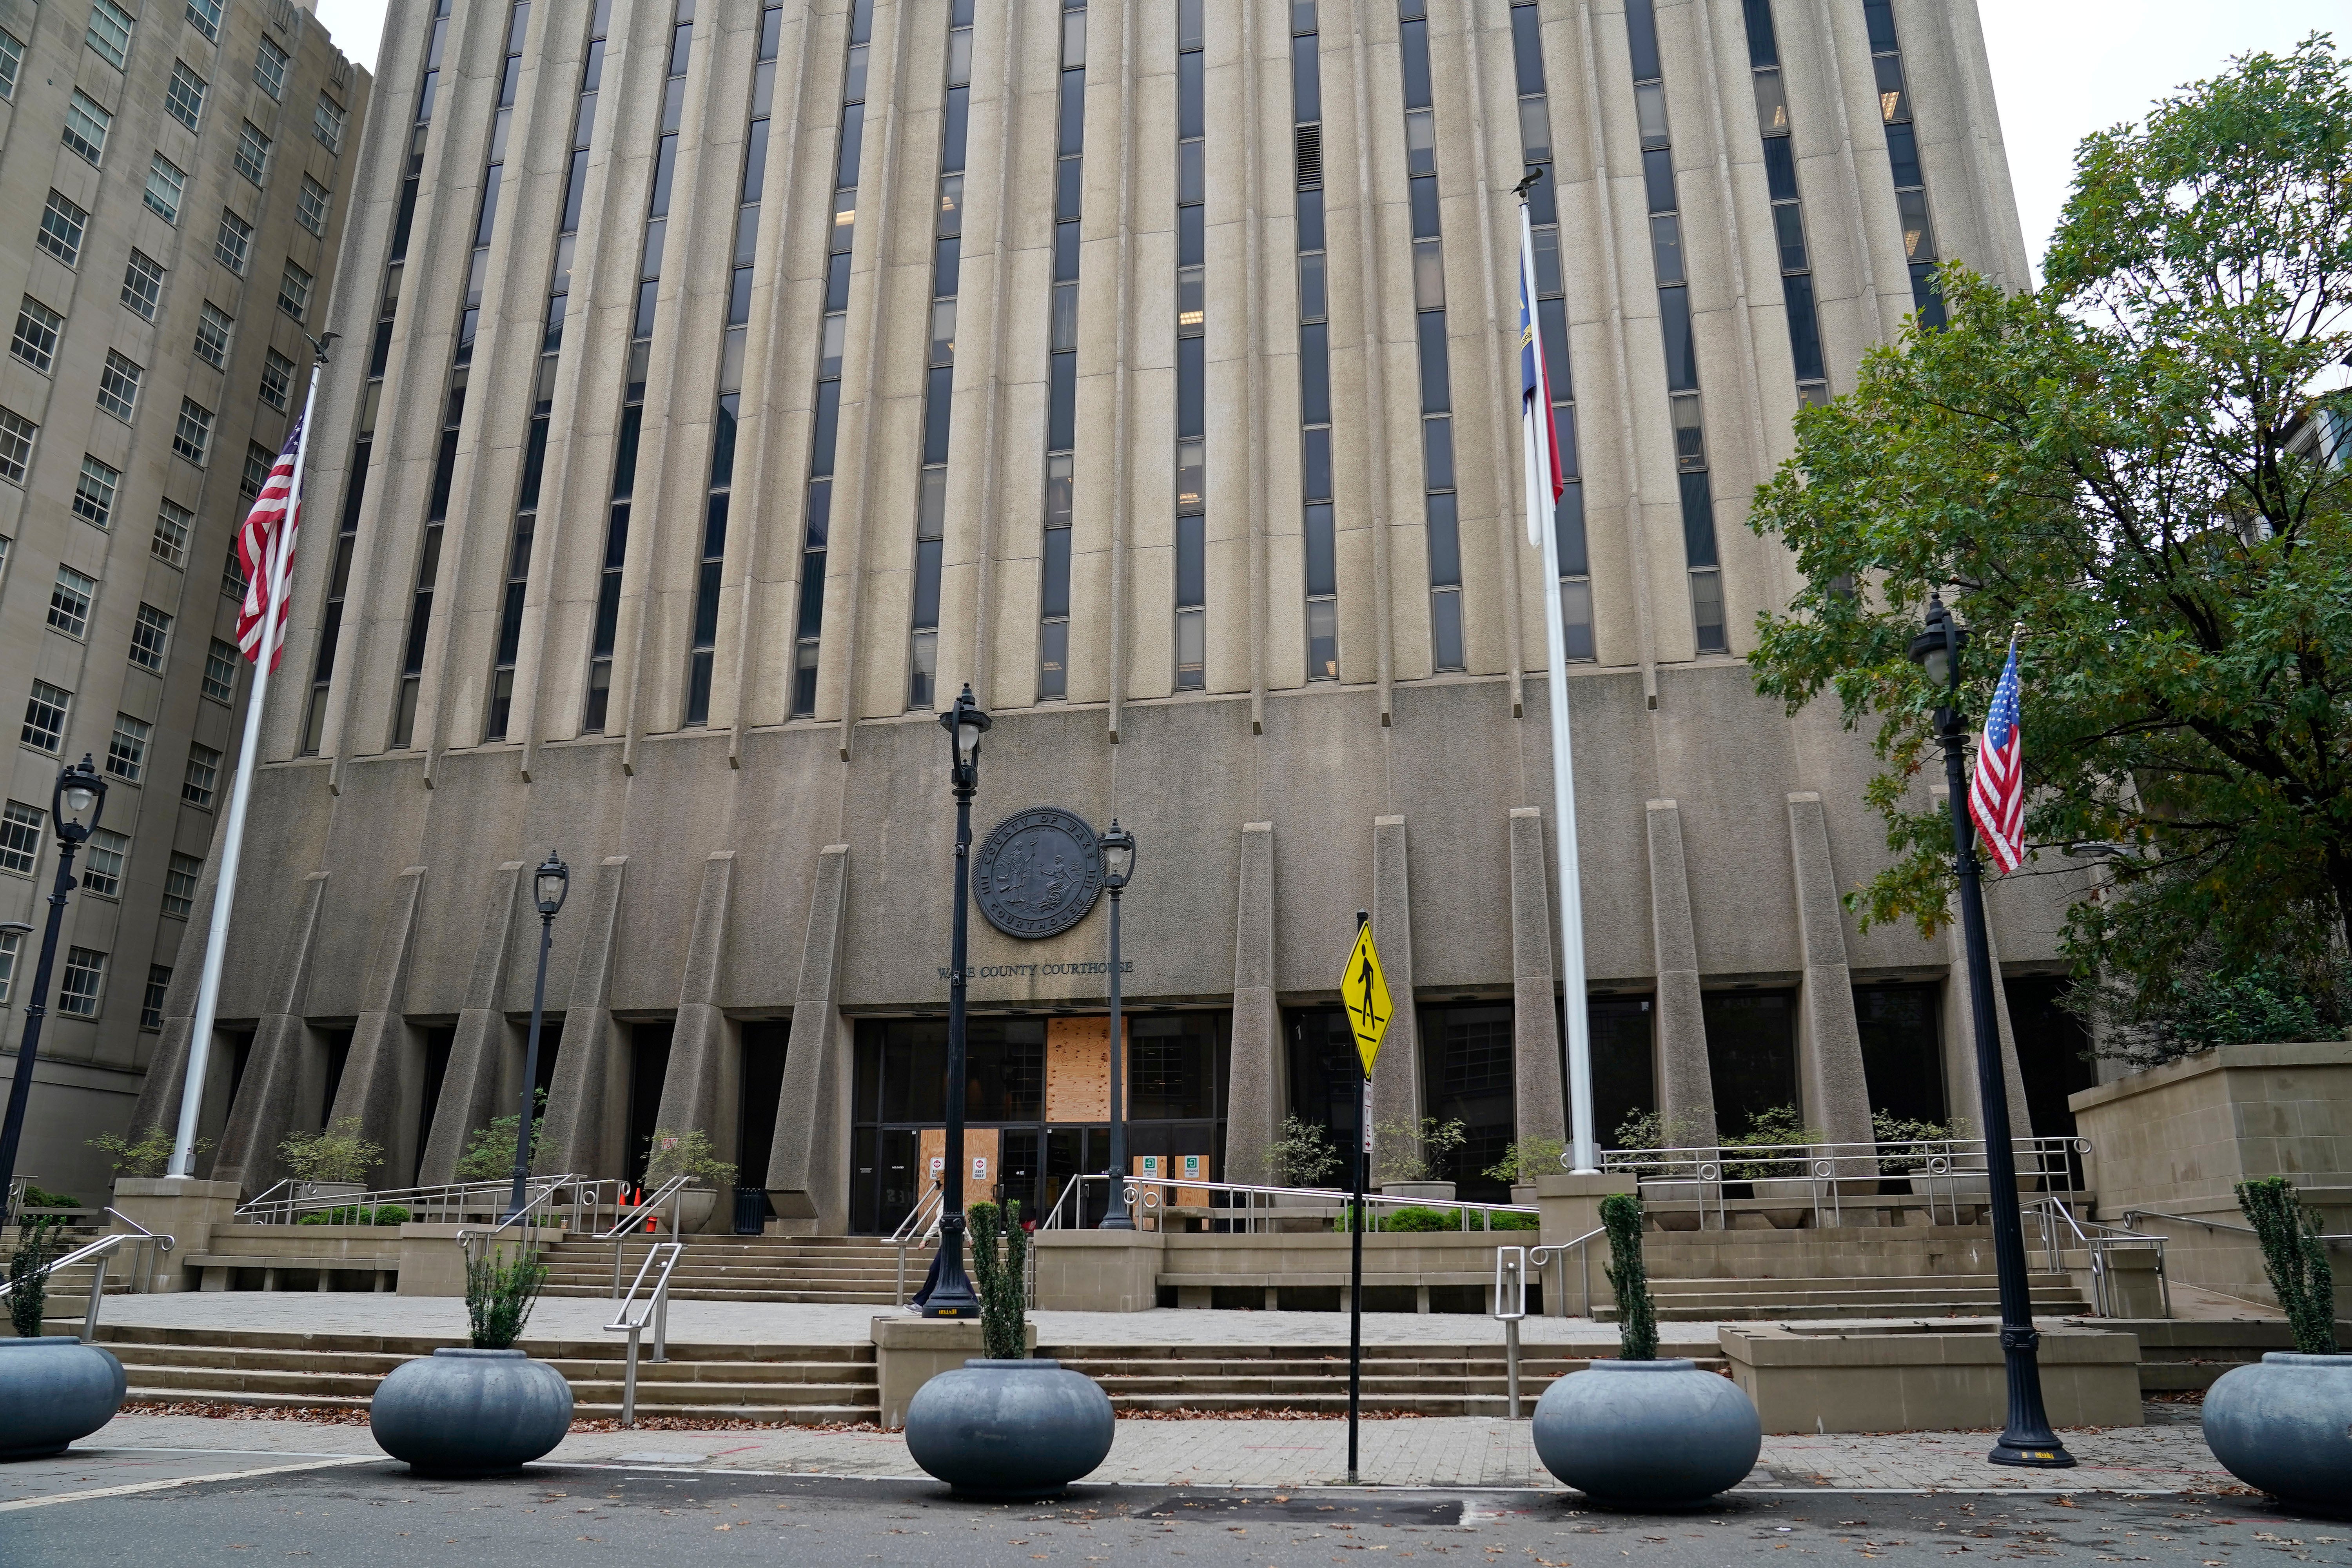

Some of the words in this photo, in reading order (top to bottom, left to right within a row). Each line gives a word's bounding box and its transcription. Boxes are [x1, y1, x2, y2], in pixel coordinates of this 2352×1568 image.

[984, 817, 1027, 864] COUNTY
[1040, 815, 1058, 824] OF
[1067, 823, 1094, 858] WAKE
[991, 898, 1084, 929] COURTHOUSE
[938, 967, 975, 978] WE
[980, 965, 1037, 977] COUNTY
